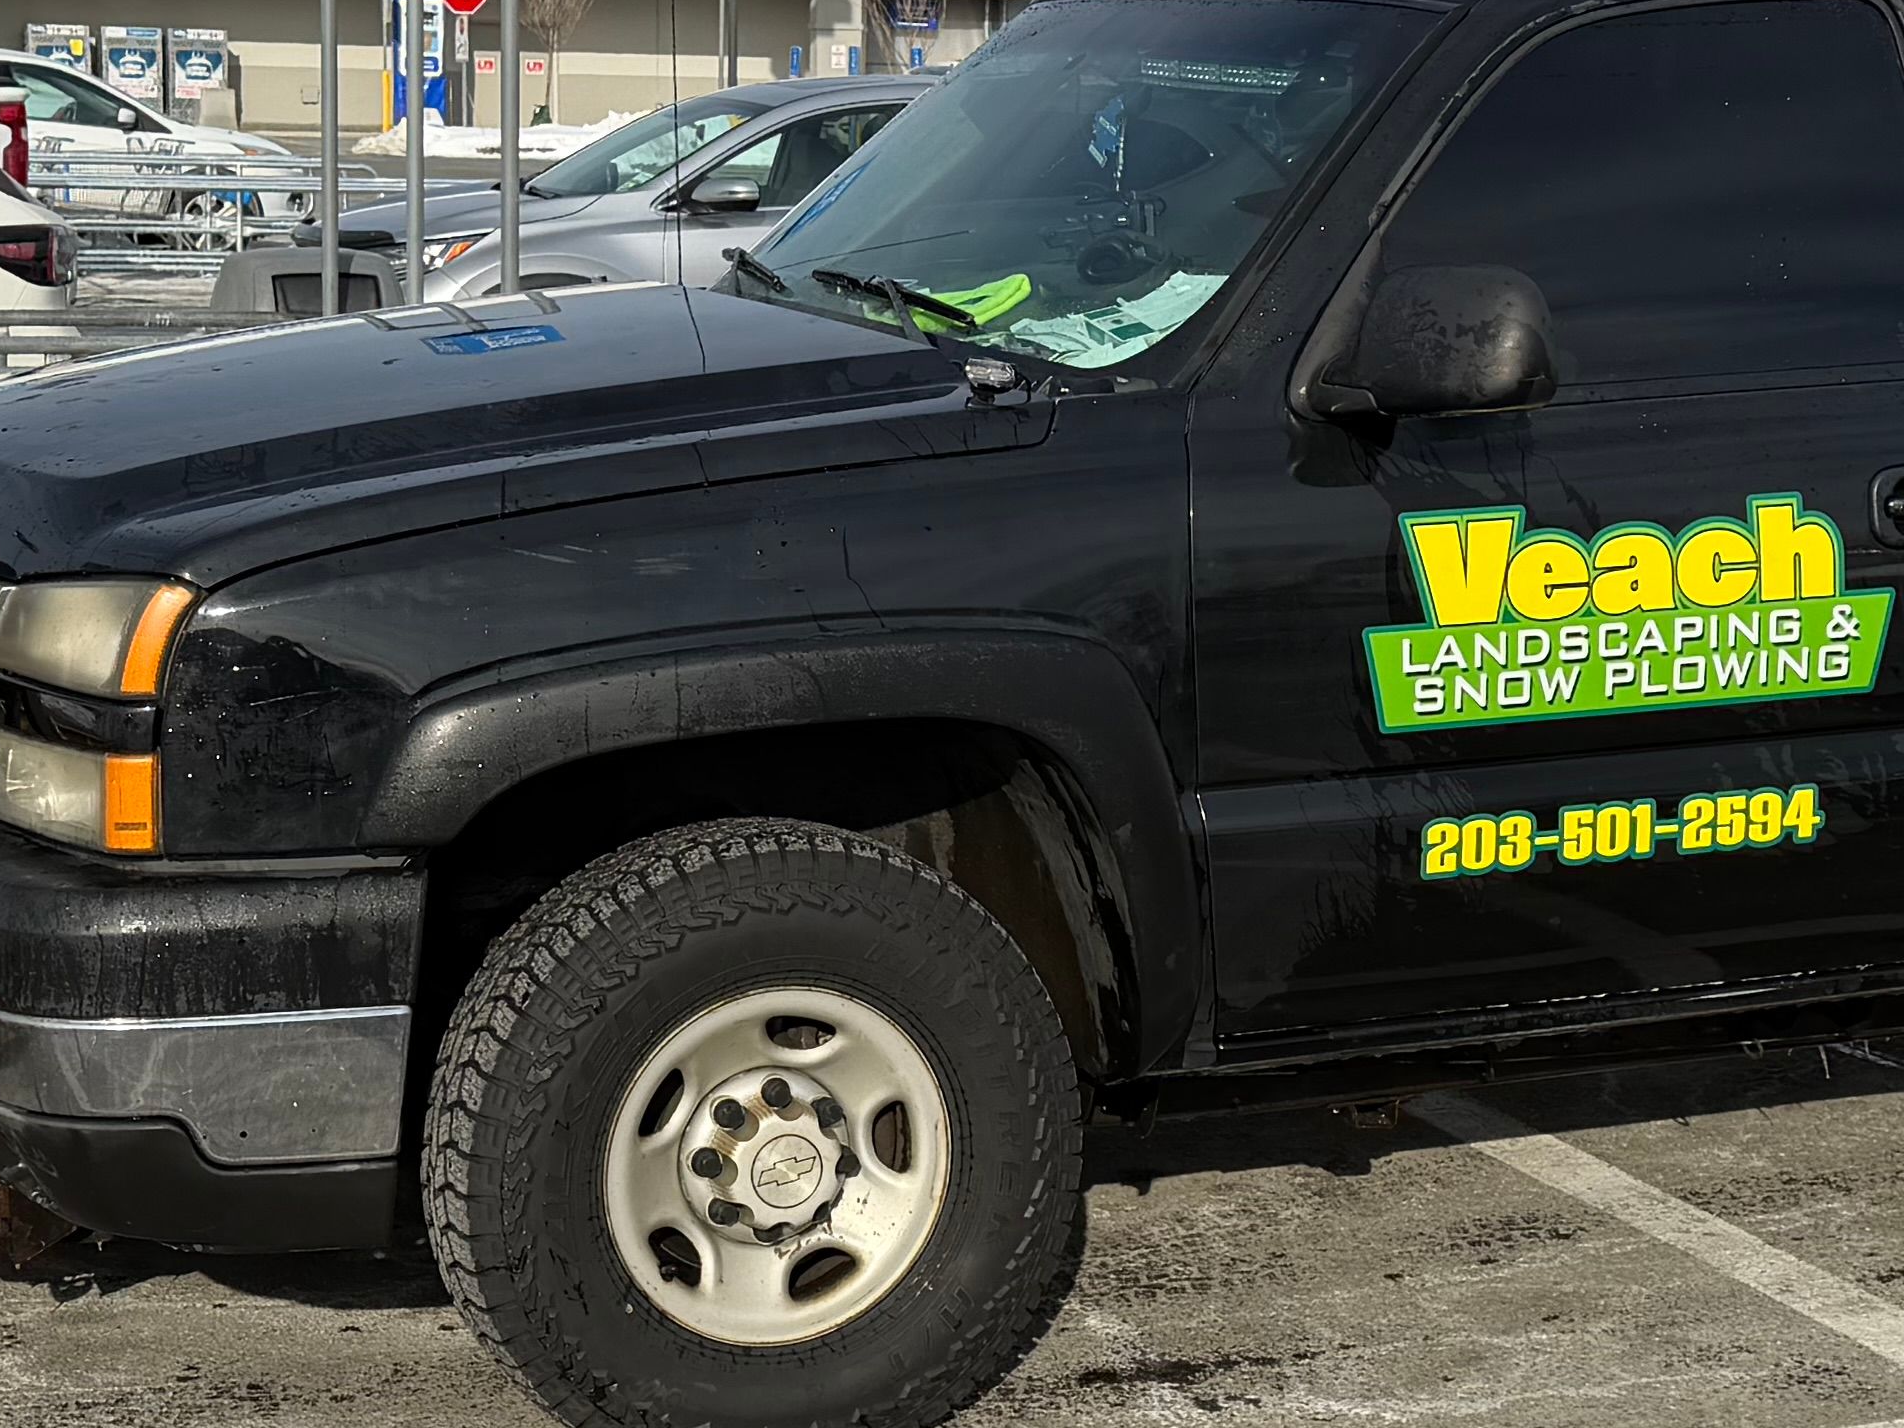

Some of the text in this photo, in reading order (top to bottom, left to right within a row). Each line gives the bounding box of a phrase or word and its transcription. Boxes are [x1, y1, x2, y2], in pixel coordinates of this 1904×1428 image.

[1411, 504, 1835, 627] Veach
[1401, 604, 1861, 675] LANDSCAPING &
[1412, 643, 1850, 714] SNOW PLOWING
[1425, 788, 1821, 874] 203-501-2594
